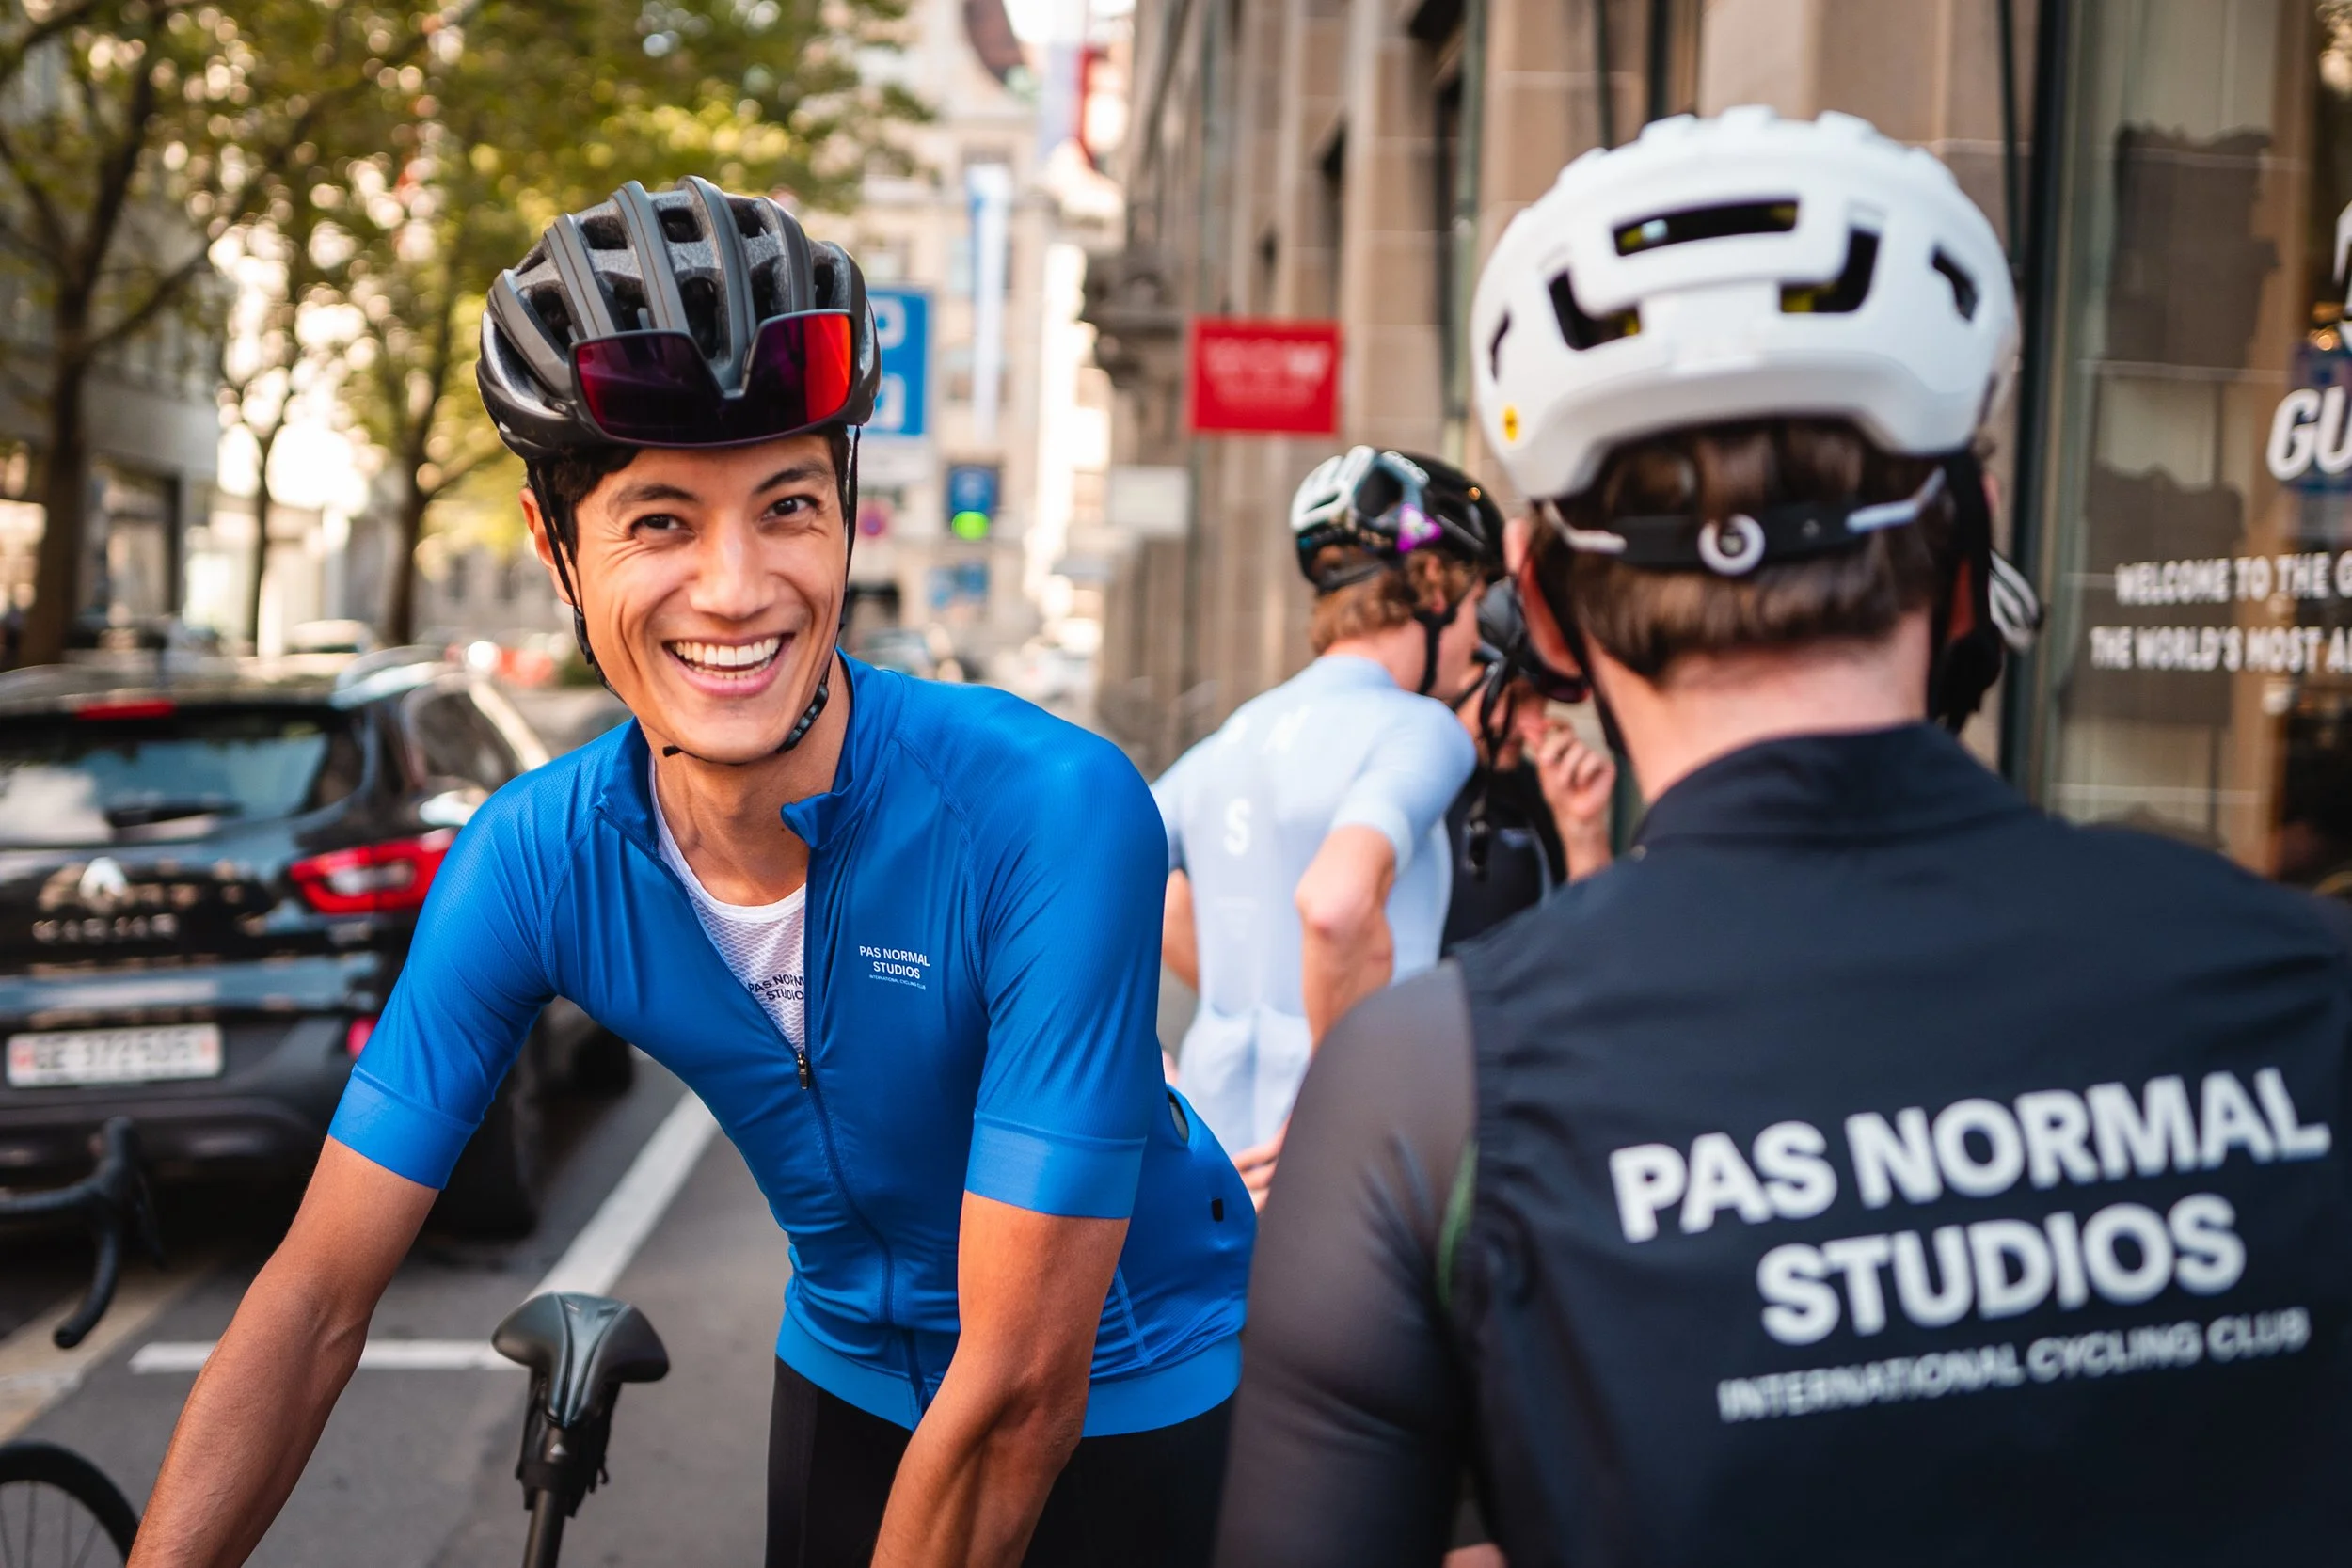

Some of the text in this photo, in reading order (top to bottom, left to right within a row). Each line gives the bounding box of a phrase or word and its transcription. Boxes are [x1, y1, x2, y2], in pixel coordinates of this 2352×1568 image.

[2115, 558, 2230, 605] WELCOME
[2234, 555, 2272, 601] TO
[2275, 551, 2331, 600] THE
[2090, 626, 2133, 670] THE
[2135, 626, 2243, 672] WORLD'S
[2245, 626, 2322, 673] MOST
[859, 945, 930, 967] PAS NORMAL
[873, 961, 921, 979] STUDIOS
[748, 980, 772, 992] PAS
[1609, 1067, 2331, 1243] PAS NORMAL
[1757, 1193, 2247, 1345] STUDIOS
[1716, 1307, 2312, 1422] INTERNATIONAL CYCLING CLUB
